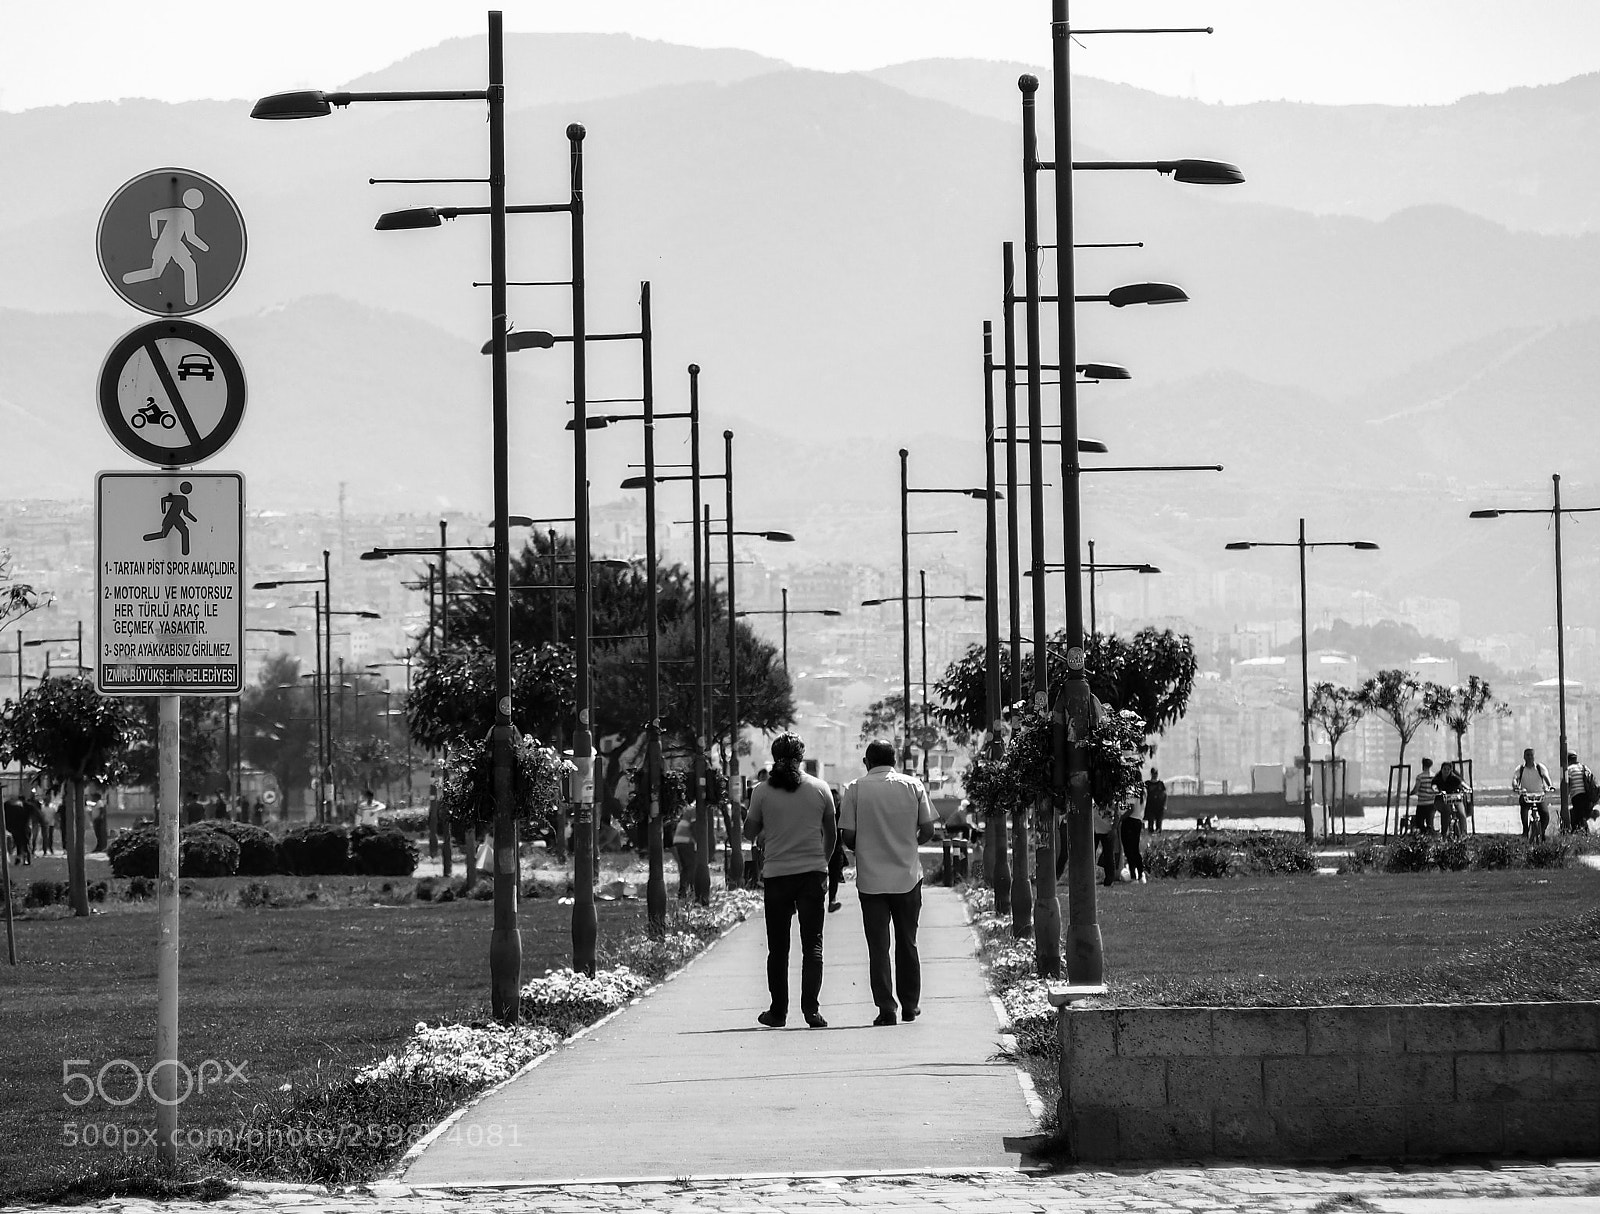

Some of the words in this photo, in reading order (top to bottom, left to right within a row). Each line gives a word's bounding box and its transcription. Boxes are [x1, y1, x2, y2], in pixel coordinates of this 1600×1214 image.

[104, 561, 112, 575] 1-
[113, 561, 145, 575] TARTAN
[147, 558, 165, 575] PİST
[166, 561, 189, 575] SPOR
[191, 561, 237, 578] AMAÇLIDIR.
[104, 586, 112, 599] 2-
[114, 586, 160, 599] MOTORLU
[165, 586, 177, 599] VE
[180, 586, 232, 599] MOTORSUZ
[114, 603, 133, 617] HER
[138, 601, 169, 617] TÜRLÜ
[173, 603, 200, 620] ARAÇ
[204, 600, 218, 617] İLE
[114, 620, 154, 637] GEÇMEK
[159, 620, 208, 635] YASAKTIR.
[104, 643, 112, 656] 3-
[113, 643, 136, 656] SPOR
[137, 643, 190, 656] AYAKKABISIZ
[192, 640, 232, 656] GİRİLMEZ.
[186, 665, 236, 682] BELEDİYESİ
